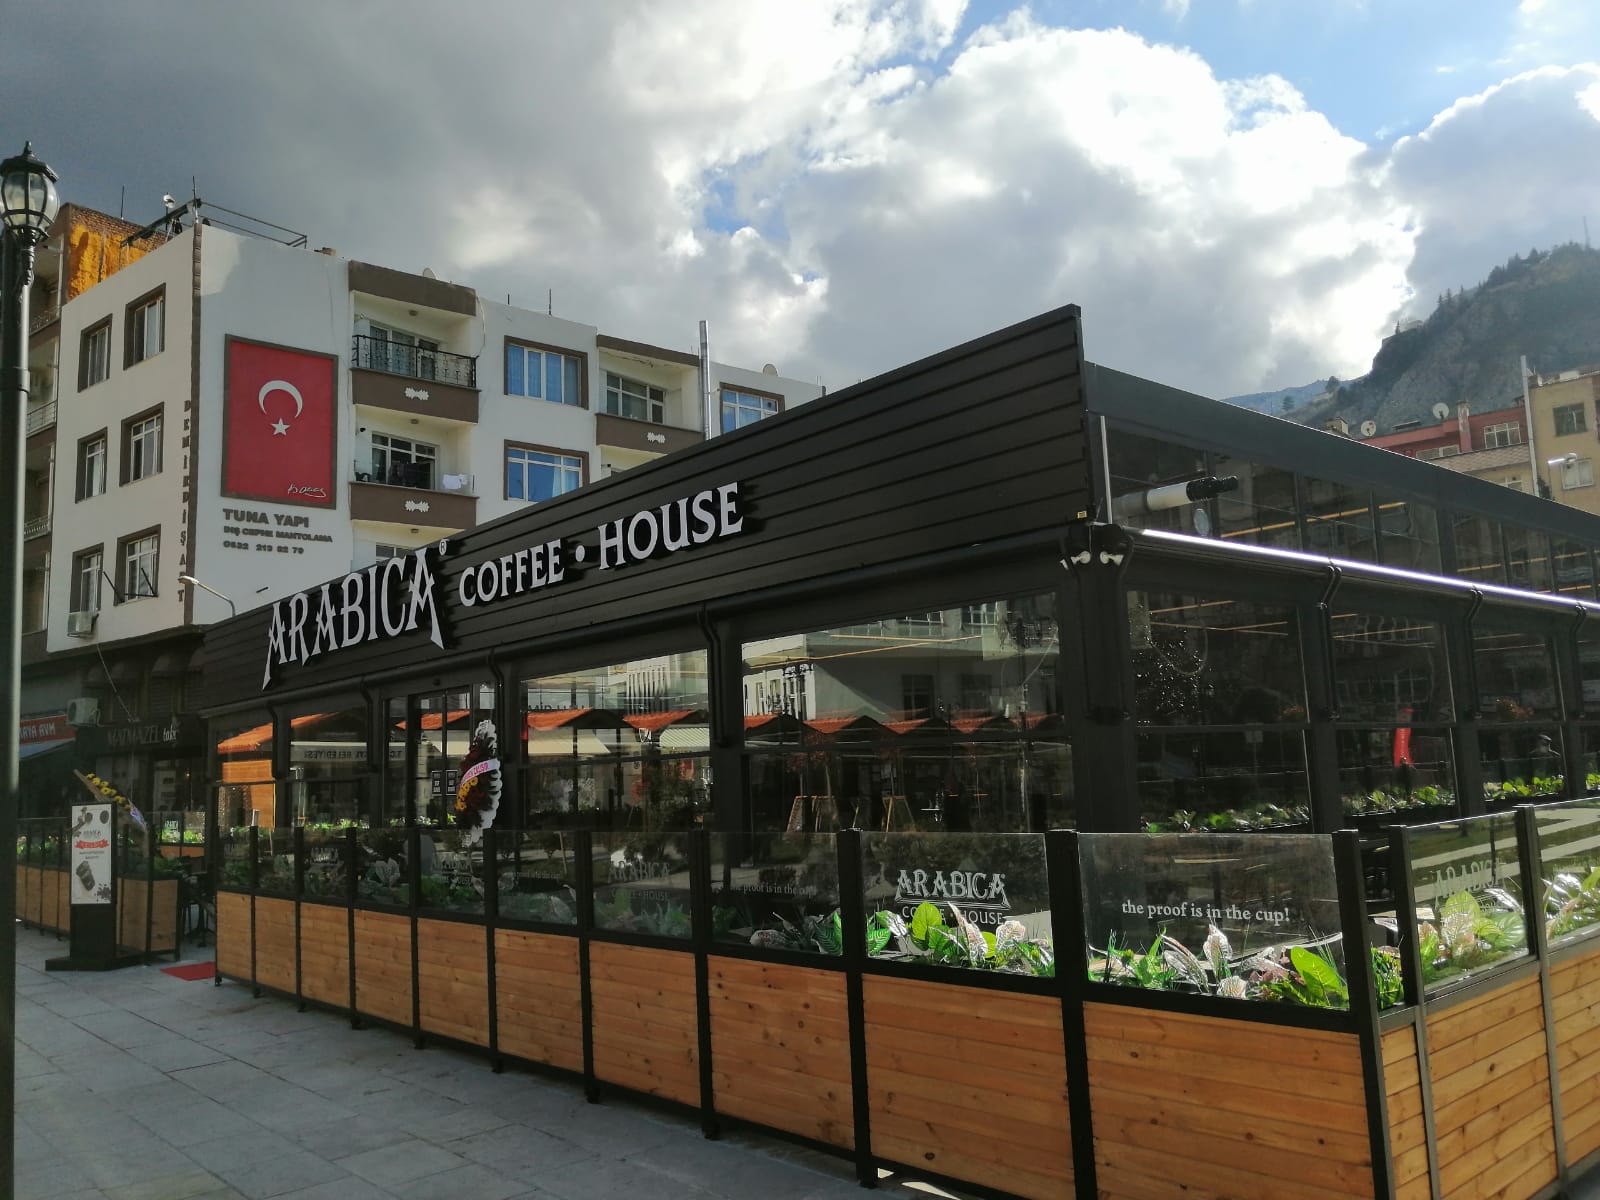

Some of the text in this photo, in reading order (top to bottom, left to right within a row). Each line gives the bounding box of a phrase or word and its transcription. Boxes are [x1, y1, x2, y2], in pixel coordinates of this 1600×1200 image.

[223, 508, 310, 528] TUNA YAPI
[262, 482, 744, 690] ARABICA COFFEE HOUSE
[894, 868, 1011, 909] ARABICA
[1122, 899, 1290, 927] the proof is in the cup!
